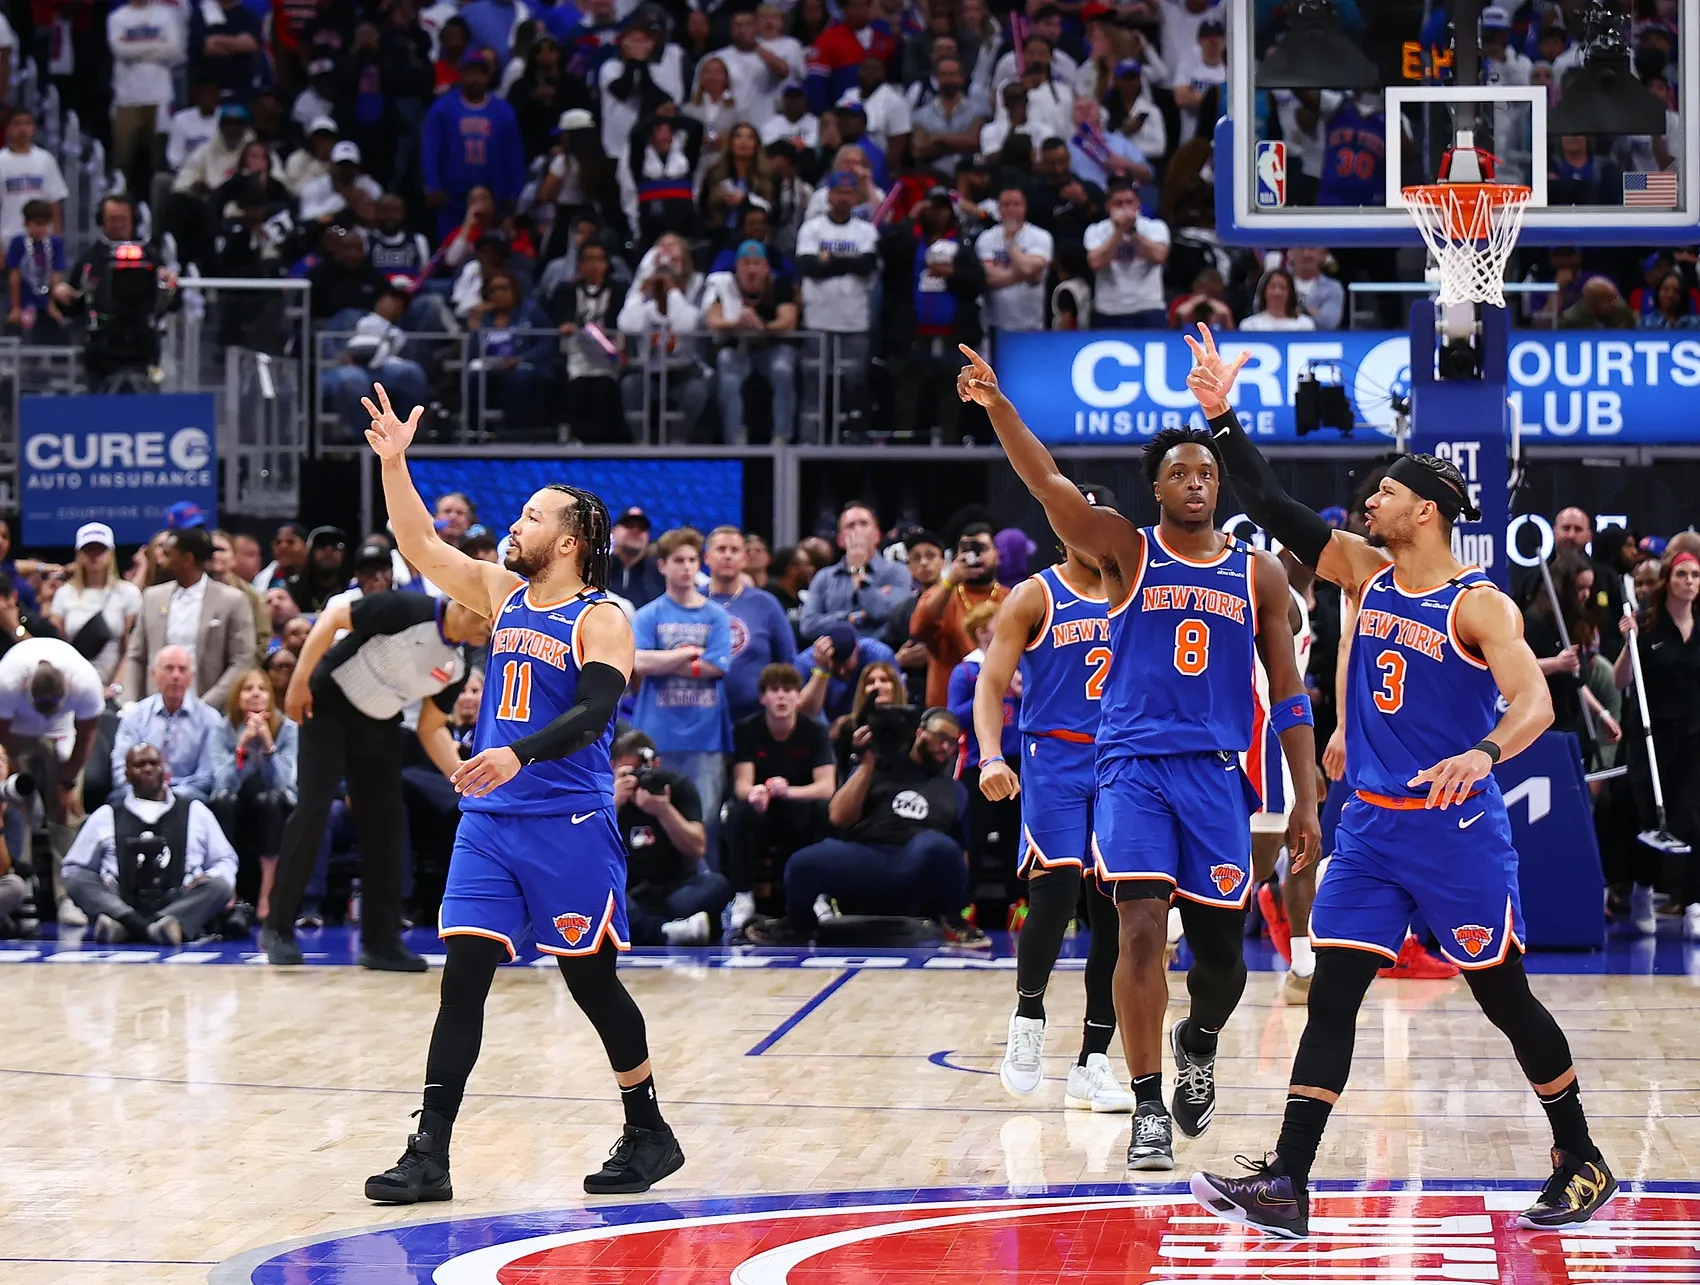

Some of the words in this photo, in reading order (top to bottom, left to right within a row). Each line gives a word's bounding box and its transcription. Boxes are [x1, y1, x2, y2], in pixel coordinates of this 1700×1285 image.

[1336, 148, 1375, 179] 30
[1508, 340, 1700, 387] OURTS
[1075, 410, 1275, 435] INSURACE
[1509, 390, 1624, 436] LUB
[24, 432, 166, 470] CURE
[27, 472, 83, 490] AUTO
[89, 470, 212, 489] INSURANCE
[1142, 585, 1192, 612] NEW
[1192, 585, 1247, 626] YORK
[491, 628, 523, 658] NEW
[518, 628, 571, 672] YORK
[1052, 618, 1096, 649] NEW
[1173, 618, 1211, 677] 8
[1359, 608, 1399, 640] NEW
[1394, 617, 1448, 663] YORK
[496, 660, 532, 723] 11
[1373, 649, 1408, 715] 3
